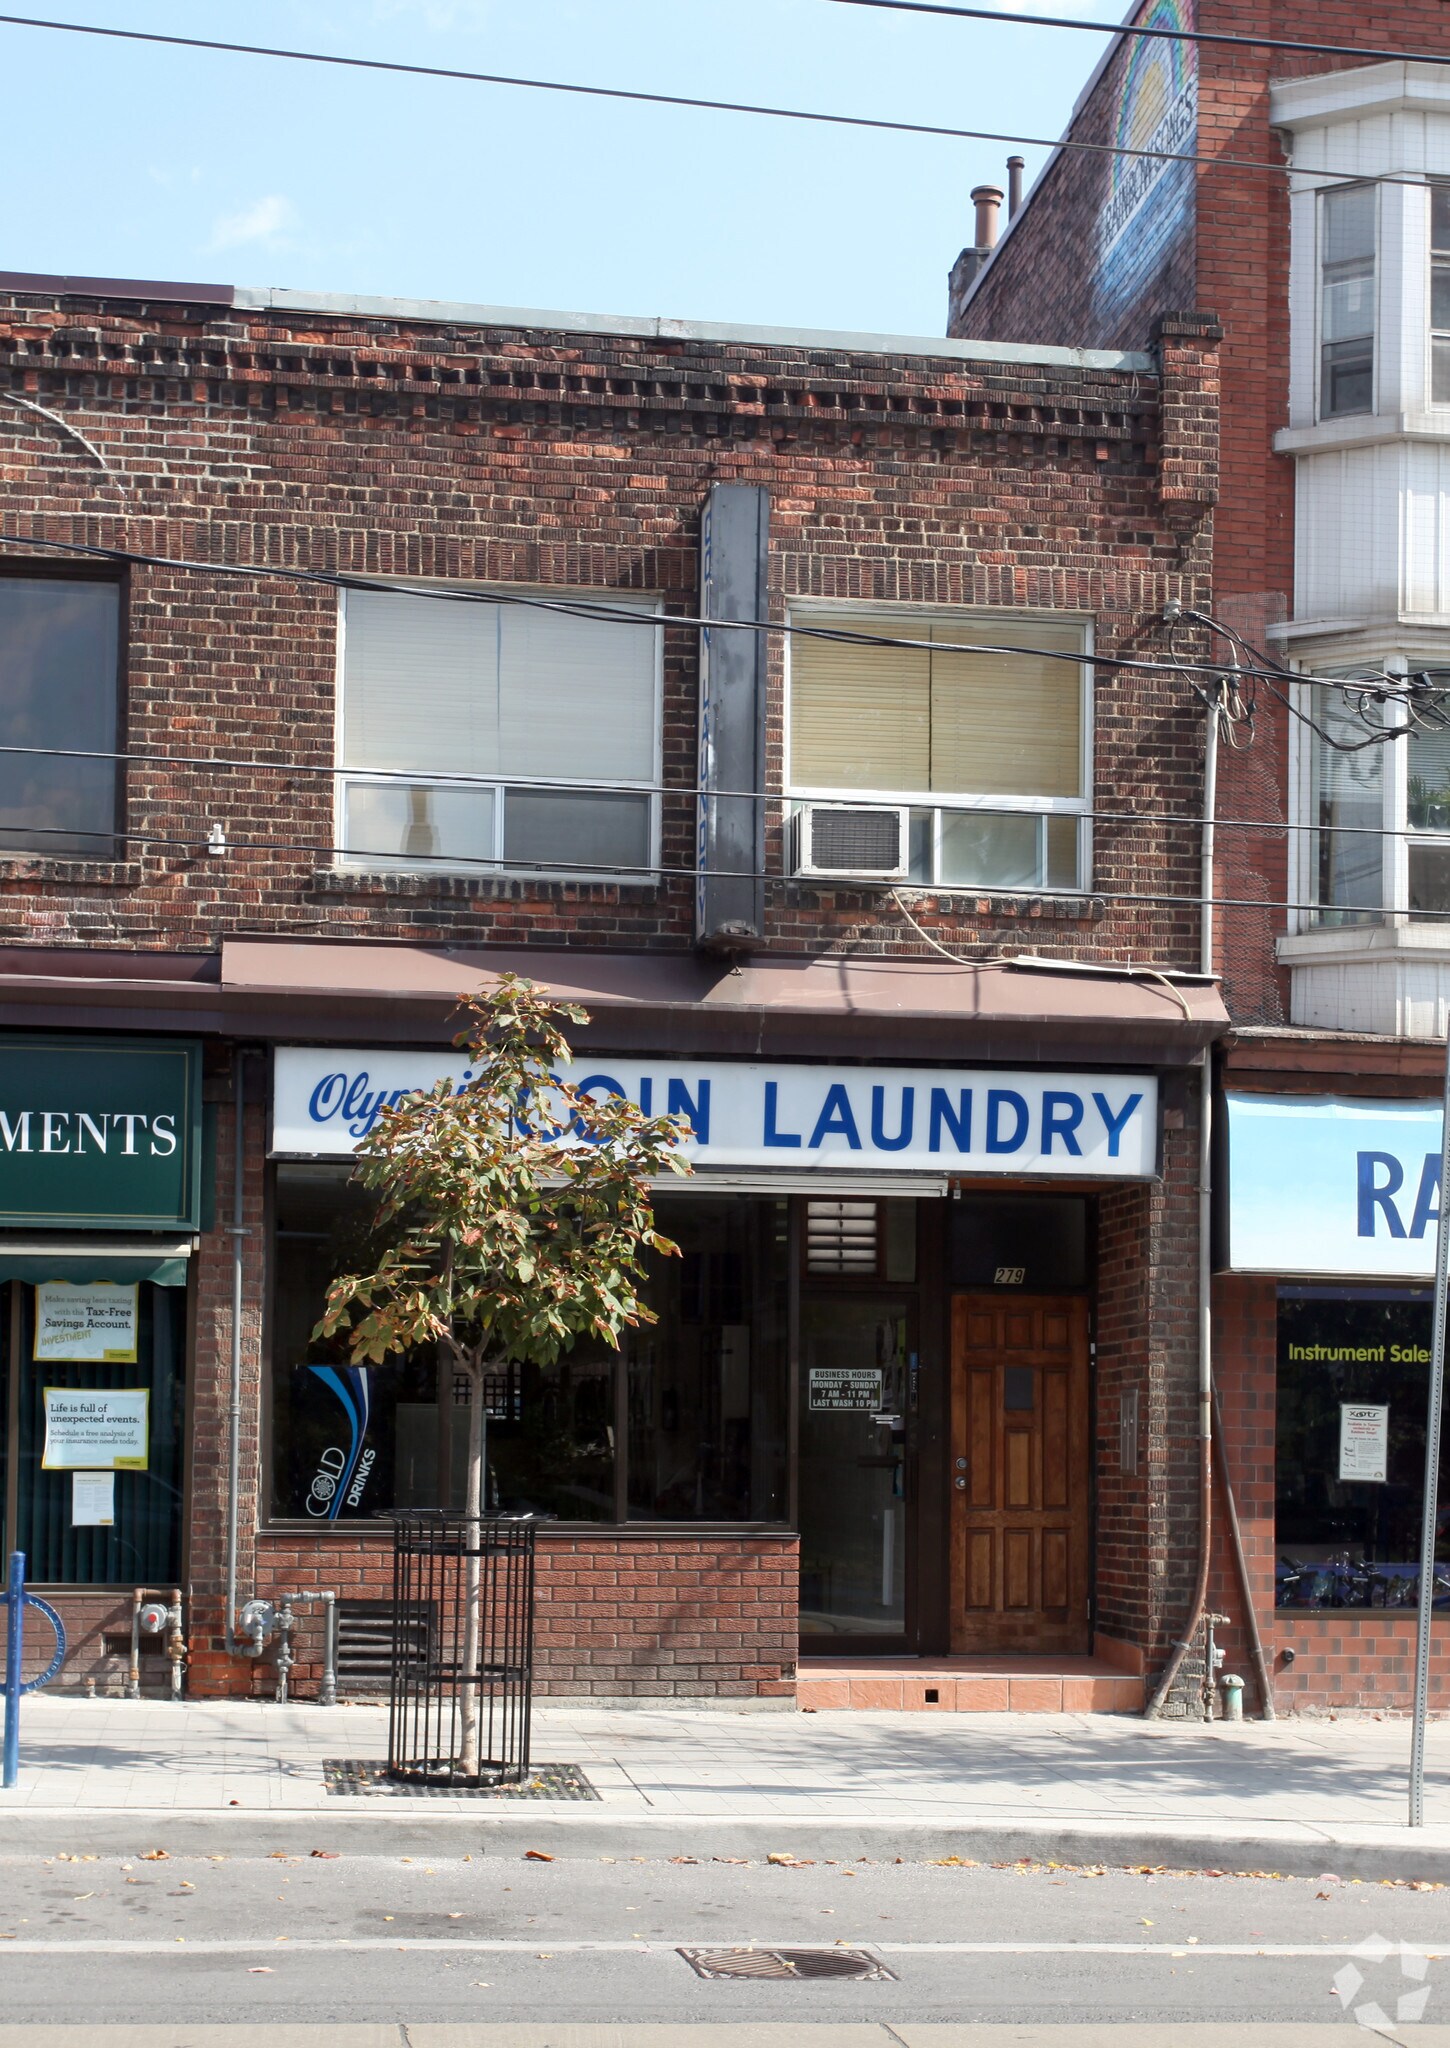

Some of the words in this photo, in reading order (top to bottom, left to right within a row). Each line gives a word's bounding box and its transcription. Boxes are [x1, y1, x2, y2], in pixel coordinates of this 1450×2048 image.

[763, 1081, 1143, 1157] LAUNDRY
[0, 1110, 177, 1156] MENTS
[996, 1269, 1024, 1282] 279
[45, 1295, 65, 1303] Make
[67, 1296, 90, 1305] saving
[92, 1296, 107, 1304] less
[108, 1297, 132, 1305] taxing
[54, 1308, 70, 1316] with
[72, 1308, 84, 1316] the
[86, 1307, 132, 1317] Tax-Free
[45, 1318, 84, 1330] Savings
[86, 1319, 131, 1329] Account.
[41, 1329, 92, 1346] INVESTMENT
[1289, 1343, 1386, 1361] Instrument
[815, 1370, 850, 1379] BUSINESS
[852, 1370, 876, 1379] HOURS
[812, 1380, 842, 1389] MONDAY
[850, 1381, 879, 1389] SUNDAY
[821, 1390, 826, 1398] 7
[828, 1390, 840, 1398] AM
[847, 1390, 856, 1398] 11
[858, 1390, 870, 1398] PM
[50, 1403, 68, 1413] Life
[70, 1404, 78, 1413] is
[80, 1404, 96, 1413] full
[98, 1404, 108, 1413] of
[813, 1399, 830, 1407] LAST
[832, 1399, 853, 1407] WASH
[855, 1399, 865, 1407] 10
[50, 1414, 105, 1425] unexpected
[106, 1415, 140, 1424] events.
[50, 1429, 79, 1437] Schedule
[85, 1429, 99, 1437] free
[100, 1430, 126, 1438] analysis
[127, 1430, 135, 1438] of
[99, 1437, 118, 1445] needs
[119, 1438, 140, 1446] today.
[306, 1447, 345, 1516] COLD
[347, 1448, 376, 1507] DRINKS
